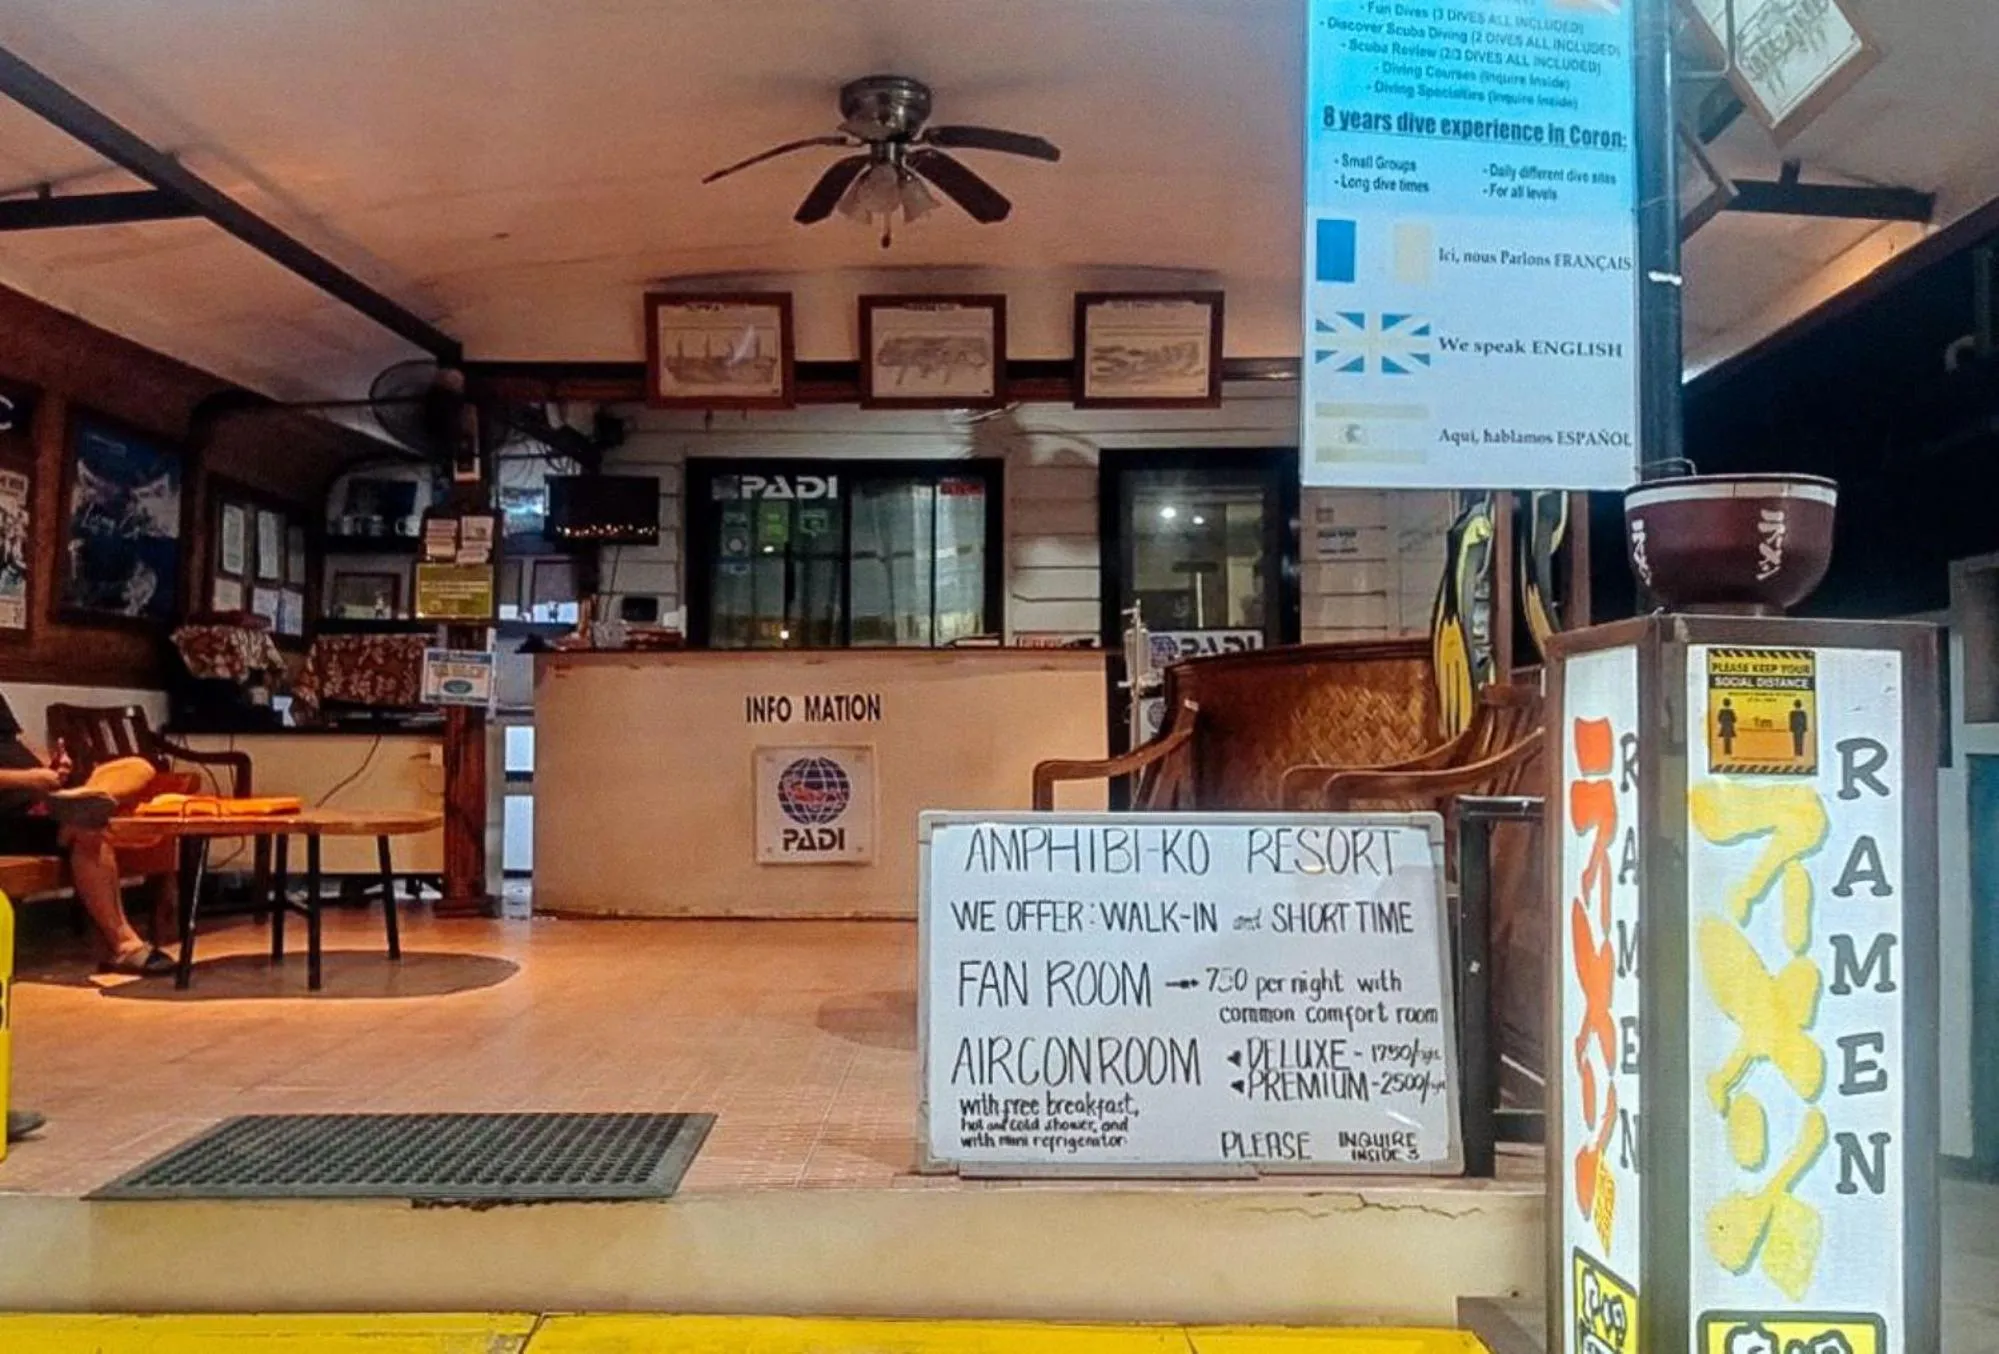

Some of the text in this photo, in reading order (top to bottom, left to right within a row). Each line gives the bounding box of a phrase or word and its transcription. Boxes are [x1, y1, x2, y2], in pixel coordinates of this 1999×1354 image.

[1327, 16, 1383, 33] Discover
[1386, 22, 1425, 38] Scuba
[1428, 27, 1468, 44] Diving
[1526, 36, 1549, 50] ALL
[1348, 38, 1388, 53] Scuba
[1505, 53, 1529, 67] ALL
[1425, 65, 1476, 81] Courses
[1323, 105, 1336, 127] 8
[1339, 109, 1392, 131] years
[1397, 112, 1436, 134] dive
[1441, 116, 1544, 142] experience
[1569, 124, 1628, 148] Coron:
[1375, 155, 1417, 174] Groups
[1519, 166, 1565, 182] different
[1567, 169, 1589, 184] dive
[1373, 176, 1396, 191] dive
[1399, 177, 1429, 192] times
[1510, 185, 1524, 198] all
[1527, 186, 1557, 200] levels
[1438, 247, 1632, 272] Ici, nous Parlons FRANÇAIS
[1438, 336, 1623, 358] We speak ENGLISH
[1483, 428, 1553, 445] hablamos
[1557, 428, 1632, 447] ESPAÑOL
[741, 475, 838, 499] PADI
[1712, 662, 1749, 673] PLEASE
[1752, 663, 1778, 673] KEEP
[1715, 676, 1809, 688] SOCIAL DISTANCE
[804, 693, 882, 723] MATION
[783, 827, 845, 851] PADI
[965, 827, 1401, 876] AMPHIBI-KO RESORT
[950, 900, 996, 932] WE
[1100, 900, 1218, 934] WALK-IN
[1271, 902, 1350, 934] SHORT
[1355, 901, 1414, 935] TIME
[1829, 737, 1898, 1196] RAMEN
[959, 960, 1029, 1008] FAN
[1047, 960, 1152, 1008] ROOM
[1256, 974, 1283, 1001] per
[1291, 967, 1344, 1001] night
[1357, 969, 1402, 993] with
[1219, 1002, 1438, 1031] common comfort room
[1247, 1038, 1350, 1070] DELUXE
[960, 1090, 1139, 1122] with free breakfast,
[961, 1117, 984, 1131] hot
[1009, 1117, 1040, 1131] cold
[1101, 1116, 1129, 1132] and
[960, 1132, 996, 1148] with
[999, 1135, 1028, 1147] mini
[1221, 1130, 1417, 1160] PLEASE INQUIRE
